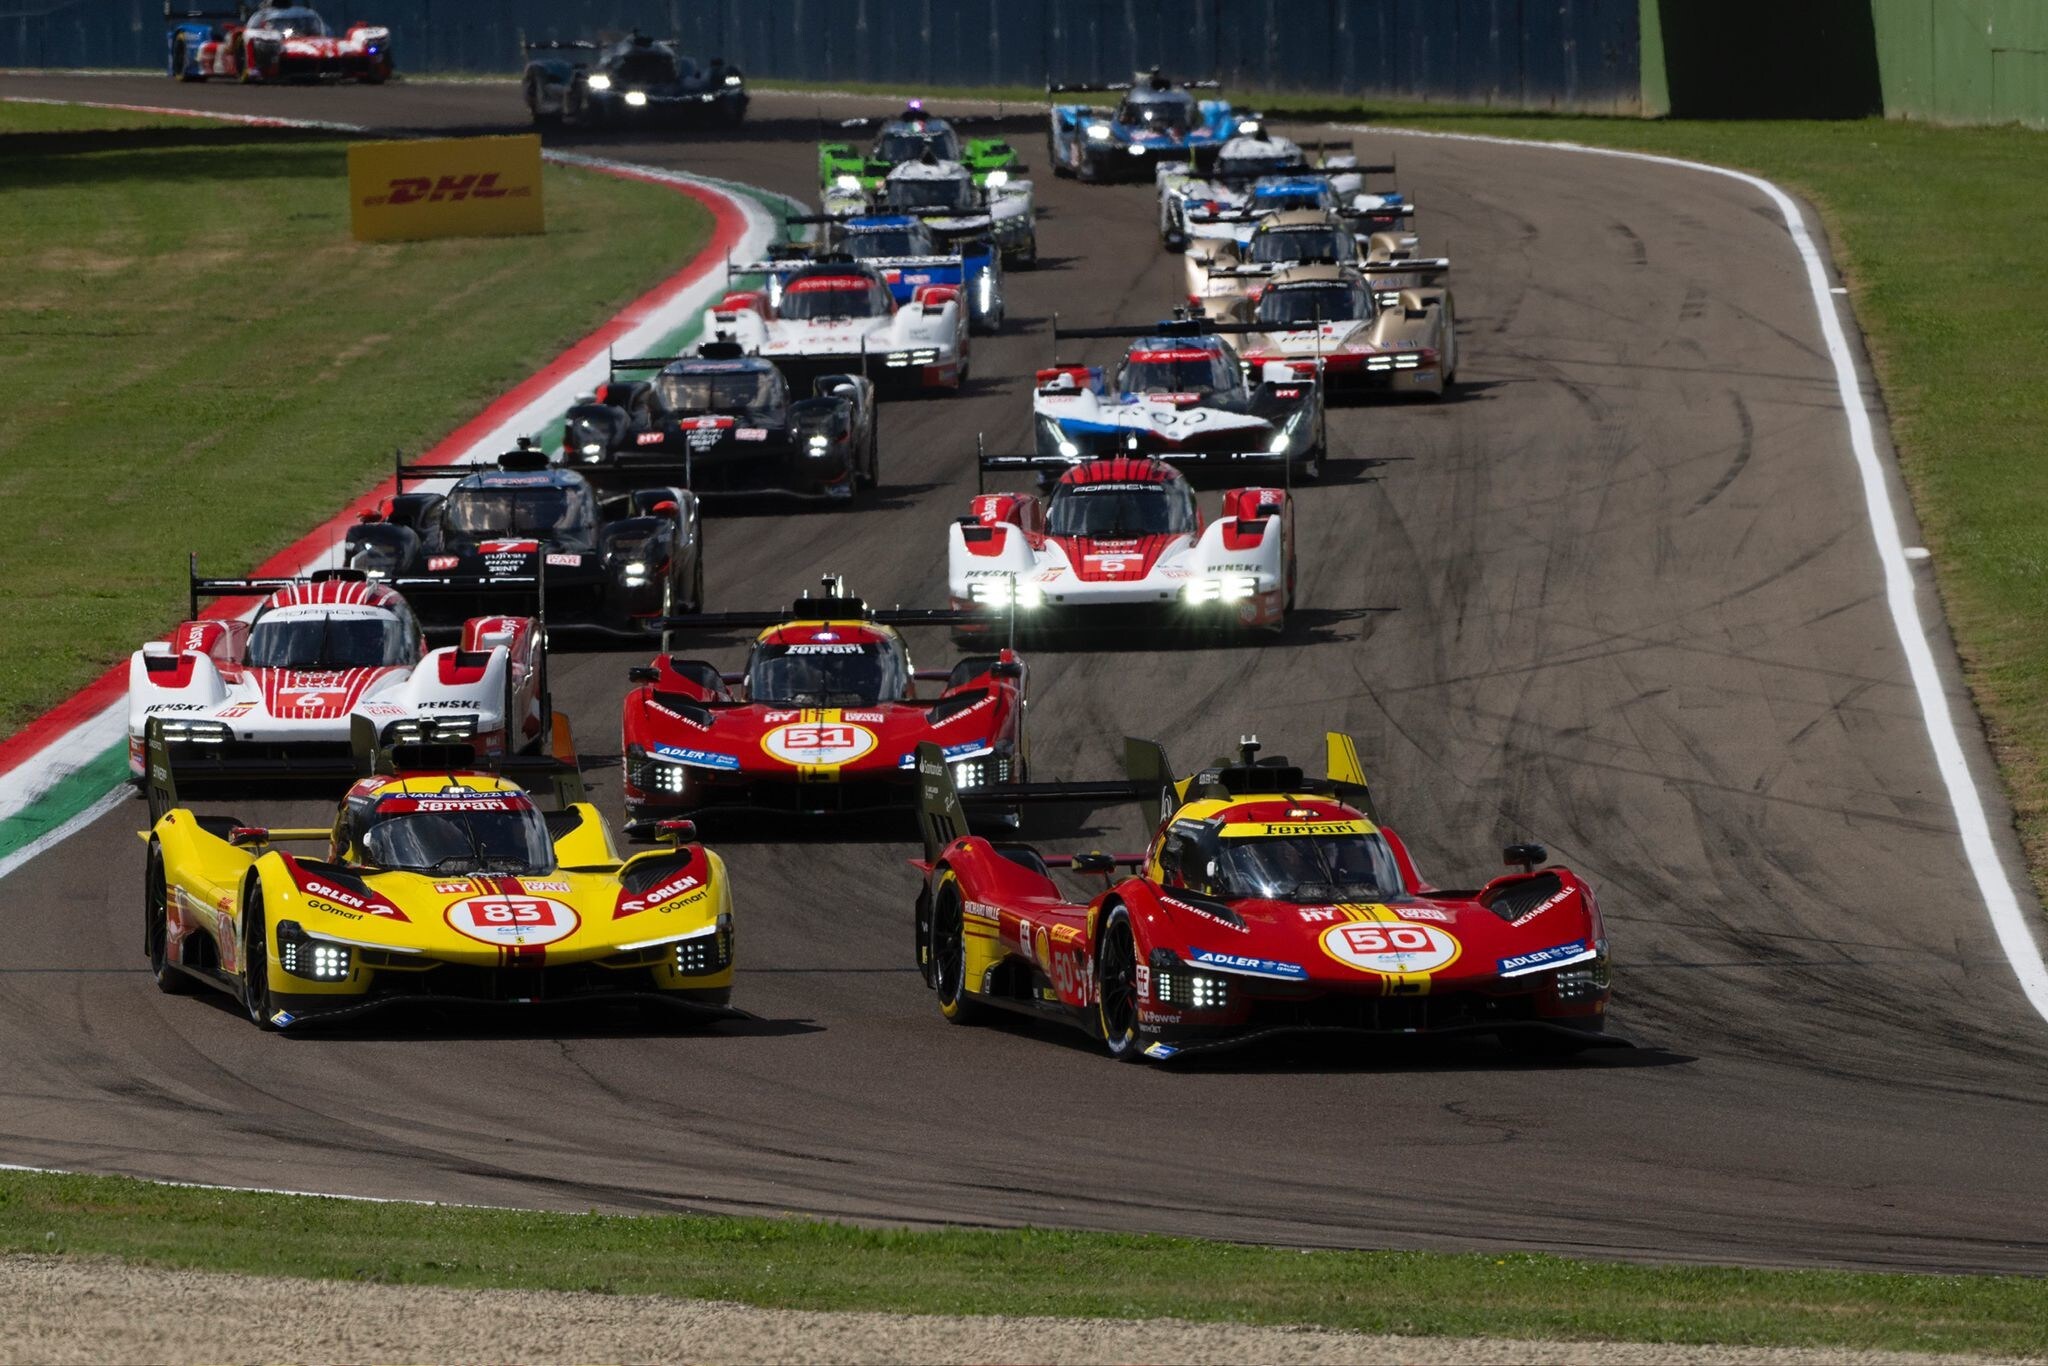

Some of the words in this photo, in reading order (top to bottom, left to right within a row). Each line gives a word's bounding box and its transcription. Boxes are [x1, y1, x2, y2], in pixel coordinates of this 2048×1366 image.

[388, 172, 508, 205] DHL
[1101, 559, 1125, 572] 5
[1208, 564, 1262, 572] PENSKE
[784, 643, 865, 655] Ferrari
[296, 692, 324, 706] 6
[417, 700, 481, 710] PENSKE
[144, 703, 208, 714] PENSKE
[764, 711, 796, 723] HY
[788, 729, 852, 746] 51
[657, 747, 705, 760] ADLER
[415, 799, 509, 811] Ferrari
[1263, 822, 1358, 835] Ferrari
[306, 882, 364, 908] ORLEN
[435, 883, 471, 893] HY
[647, 876, 698, 903] ORLEN
[307, 899, 364, 921] GOmart
[659, 891, 707, 914] GOmart
[1511, 900, 1554, 927] RICHARD
[1551, 886, 1576, 905] MILLE
[483, 903, 541, 921] 83
[1160, 896, 1211, 919] RICHARD
[1212, 916, 1250, 934] MILLE
[1299, 910, 1336, 922] HY
[1347, 929, 1428, 951] 50
[1198, 952, 1260, 968] ADLER
[1503, 950, 1551, 969] ADLER
[1055, 951, 1073, 993] 50
